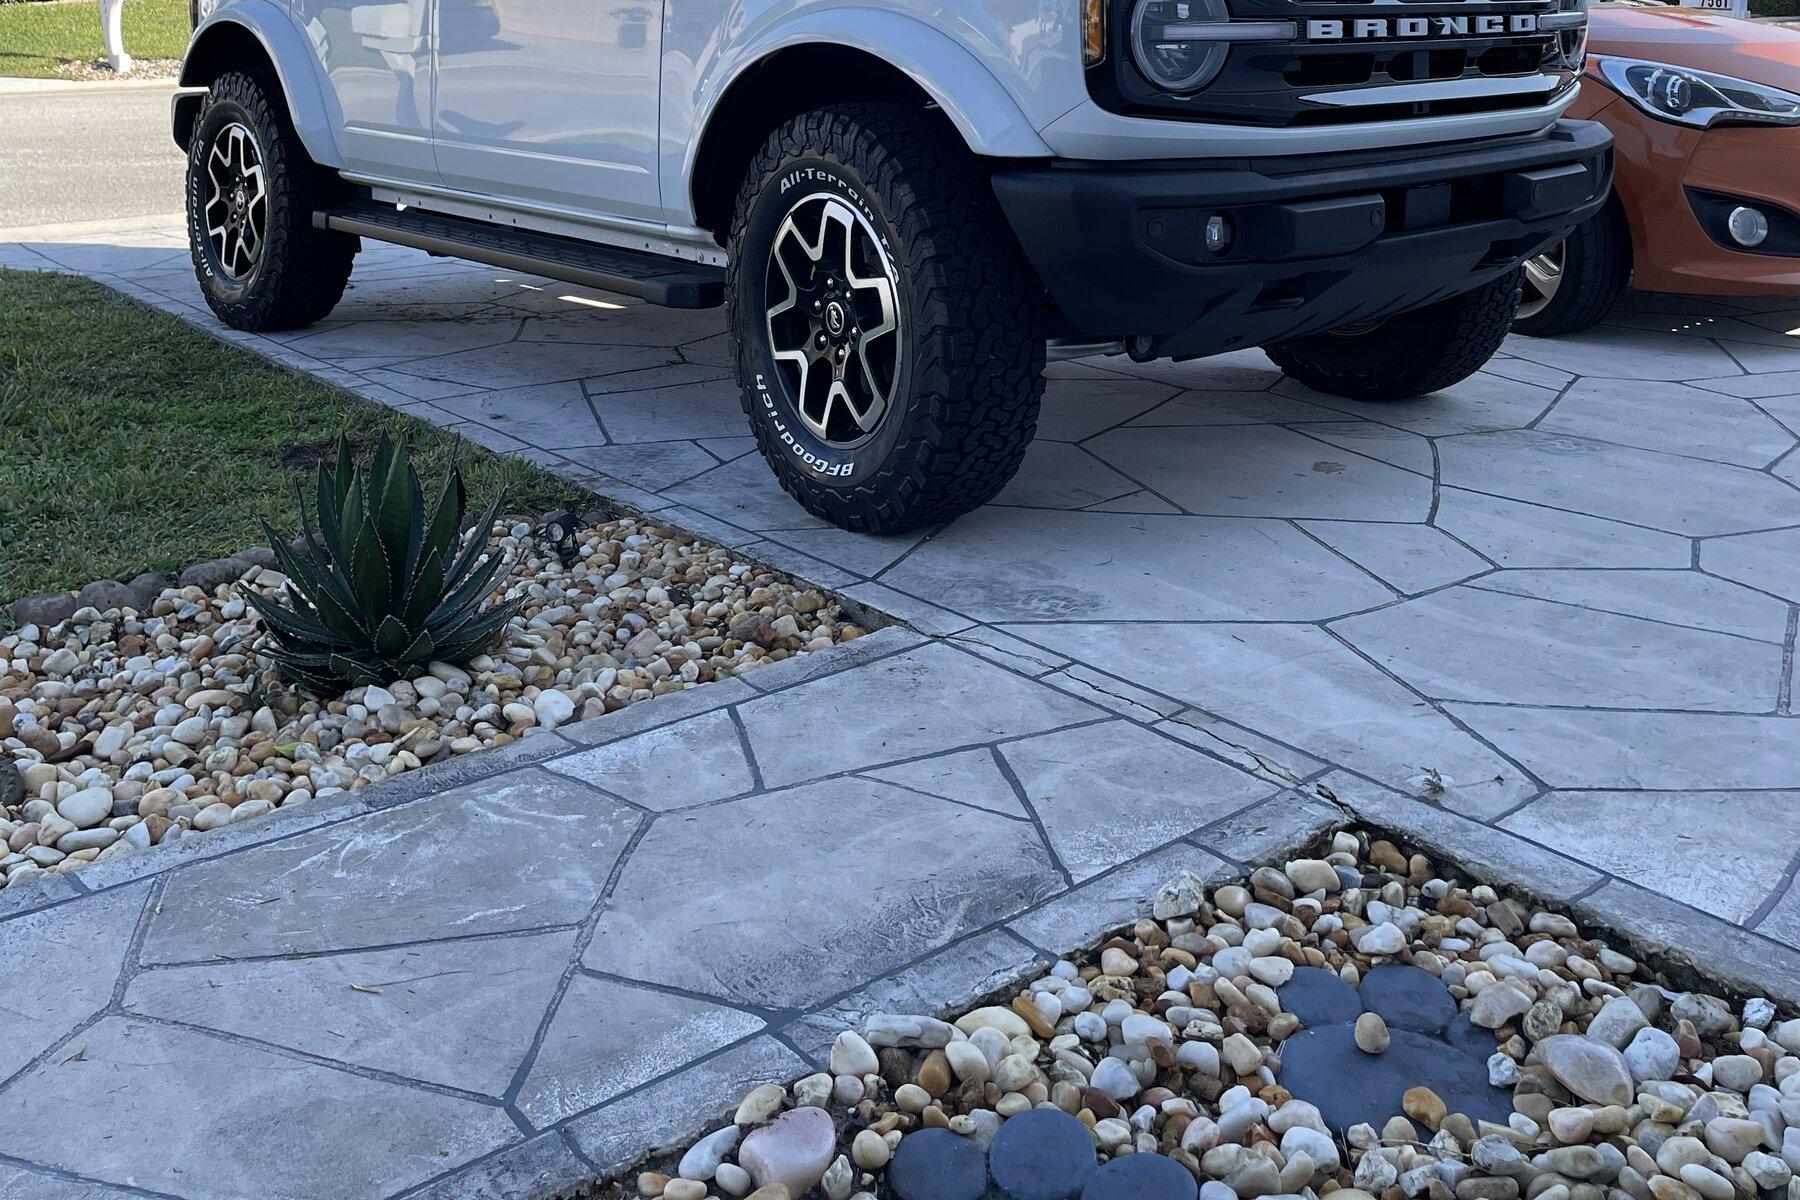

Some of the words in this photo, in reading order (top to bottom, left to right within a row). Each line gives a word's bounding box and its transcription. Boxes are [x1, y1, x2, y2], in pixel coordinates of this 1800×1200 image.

[1307, 14, 1537, 40] BRONCO
[780, 168, 874, 222] All-Terrain
[756, 374, 855, 477] BFGoodrich
